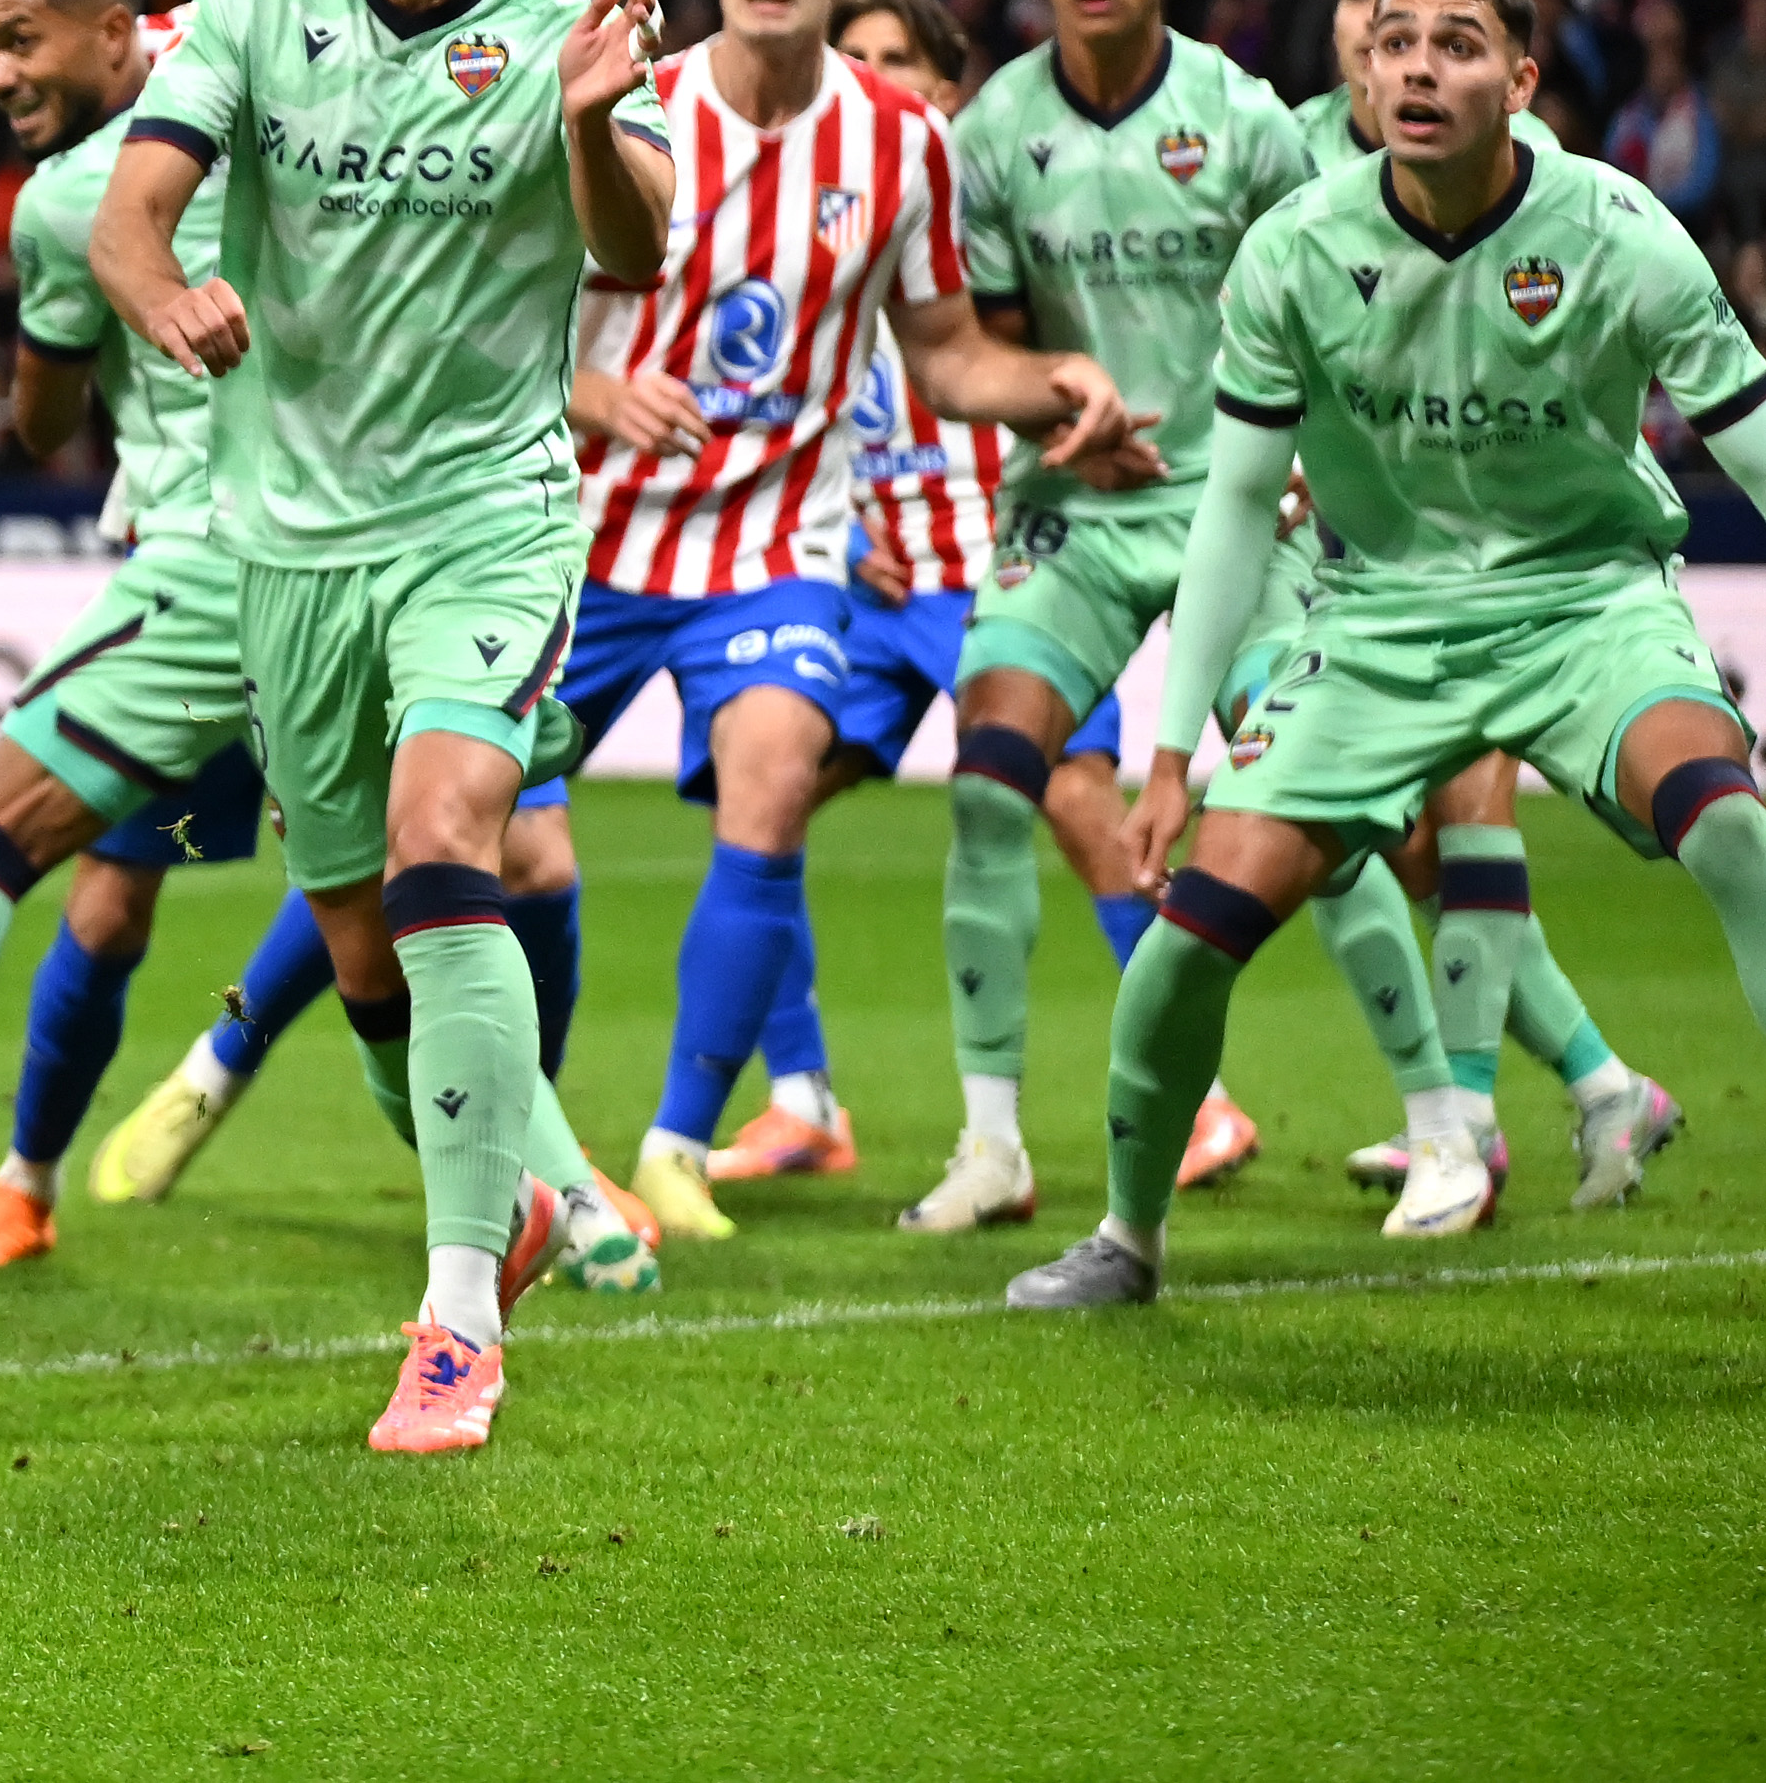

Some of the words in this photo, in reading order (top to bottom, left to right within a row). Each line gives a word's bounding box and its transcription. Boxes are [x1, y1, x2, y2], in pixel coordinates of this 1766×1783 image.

[259, 114, 495, 183] MARCOS
[1027, 225, 1216, 265] MARCOS
[1344, 383, 1568, 428] MARCOS
